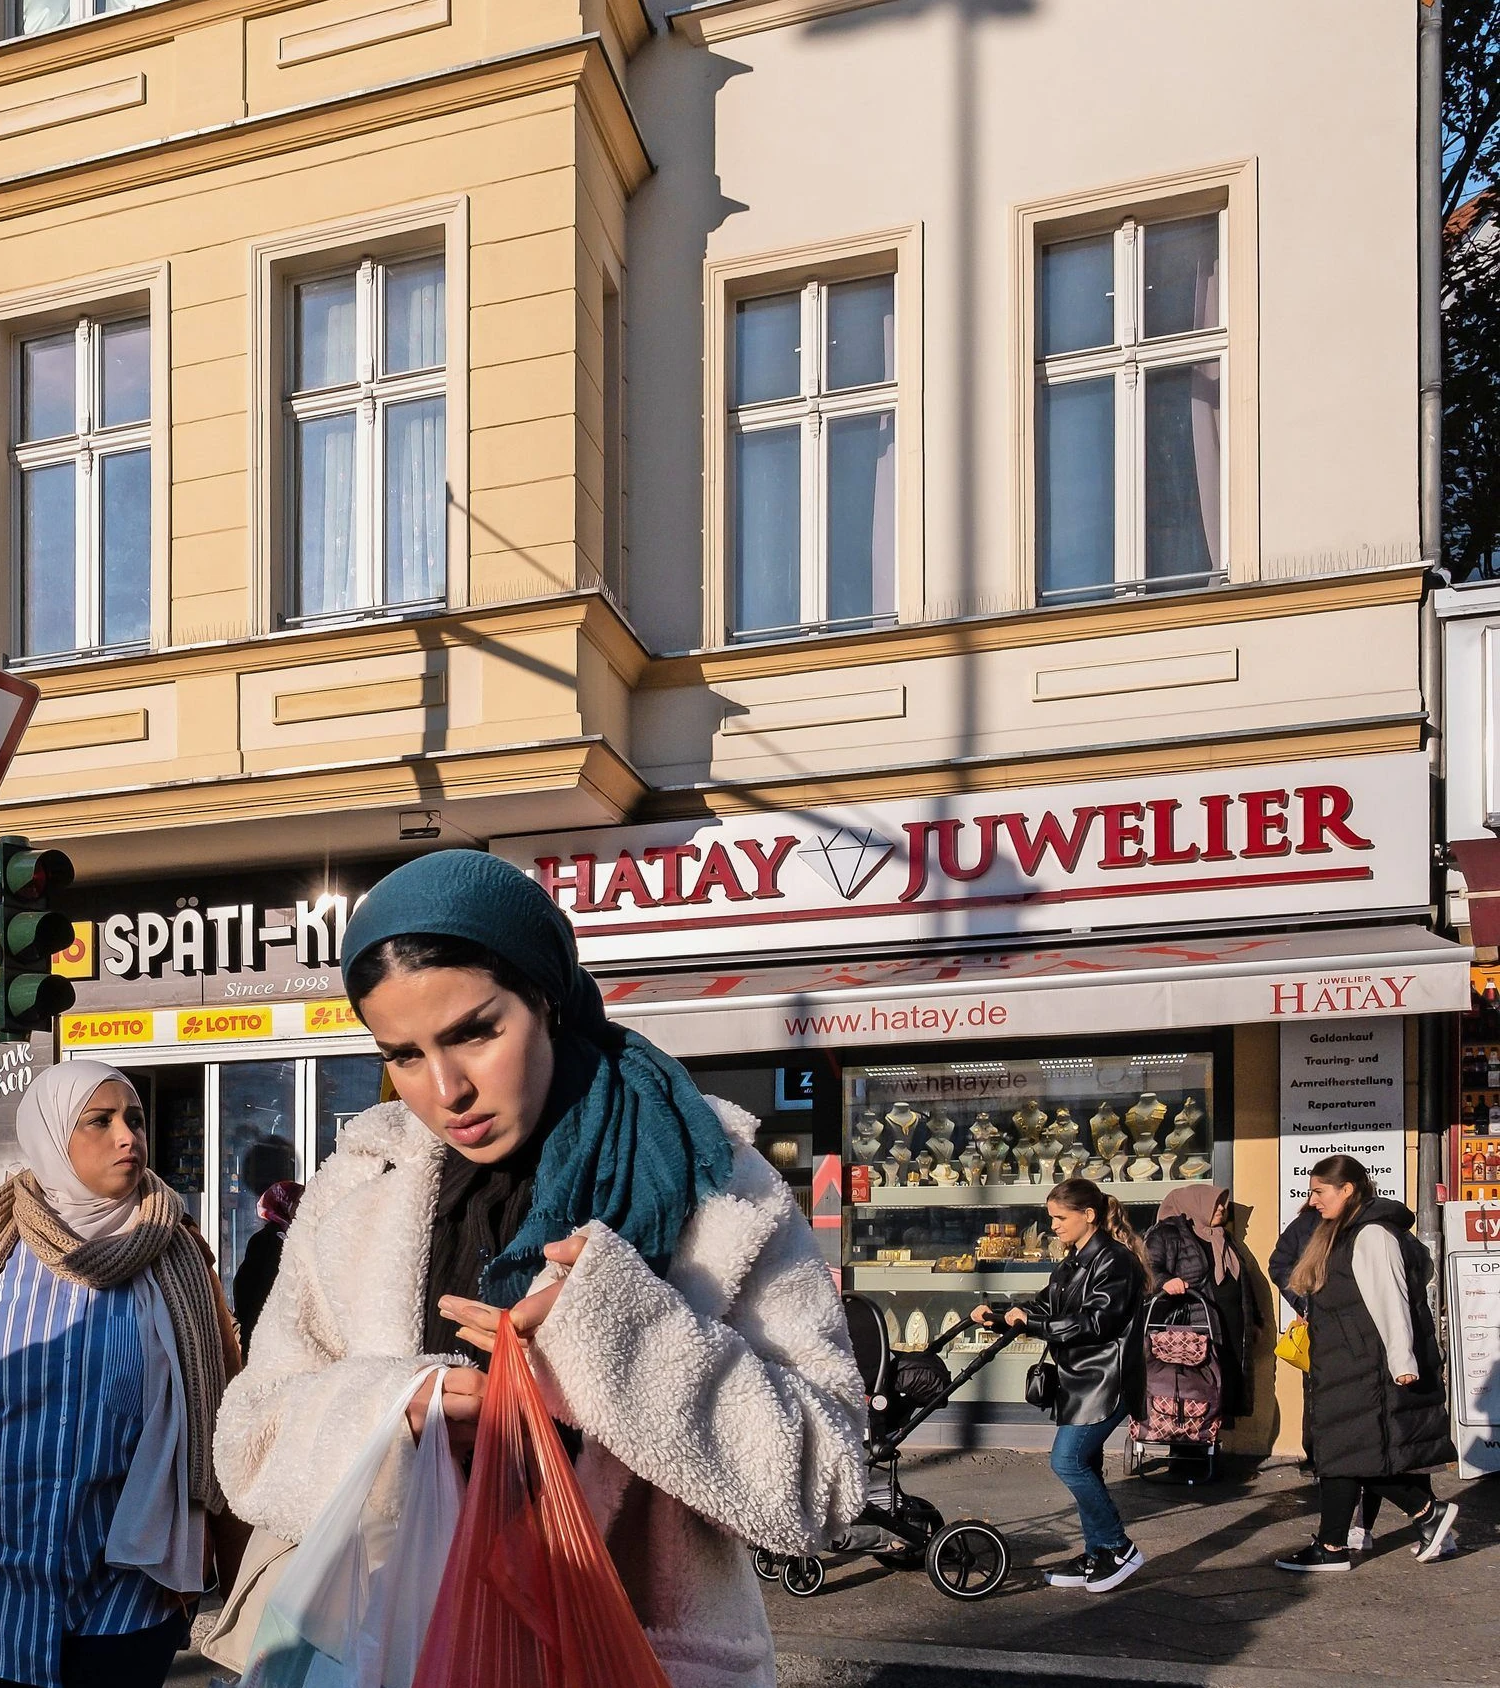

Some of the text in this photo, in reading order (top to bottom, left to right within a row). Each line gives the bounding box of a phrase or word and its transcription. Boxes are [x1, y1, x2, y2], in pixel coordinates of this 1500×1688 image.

[898, 784, 1376, 902] JUWELIER
[534, 836, 800, 913] HATAY
[104, 893, 367, 975] SPÄTI-KI
[224, 976, 330, 998] Since 1998
[1318, 975, 1371, 985] JUWELIER
[1270, 976, 1416, 1014] HATAY
[206, 1014, 262, 1032] LOTTO
[784, 1001, 1008, 1036] www.hatay.de
[91, 1020, 144, 1037] LOTTO
[1309, 1031, 1374, 1043] Goldankauf
[1304, 1053, 1379, 1066] Trauring- und
[1290, 1076, 1394, 1088] Armreifherstellung
[1308, 1100, 1376, 1111] Reparaturen
[1292, 1121, 1392, 1132] Neuanfertigungen
[1299, 1143, 1385, 1154] Umarbeitungen
